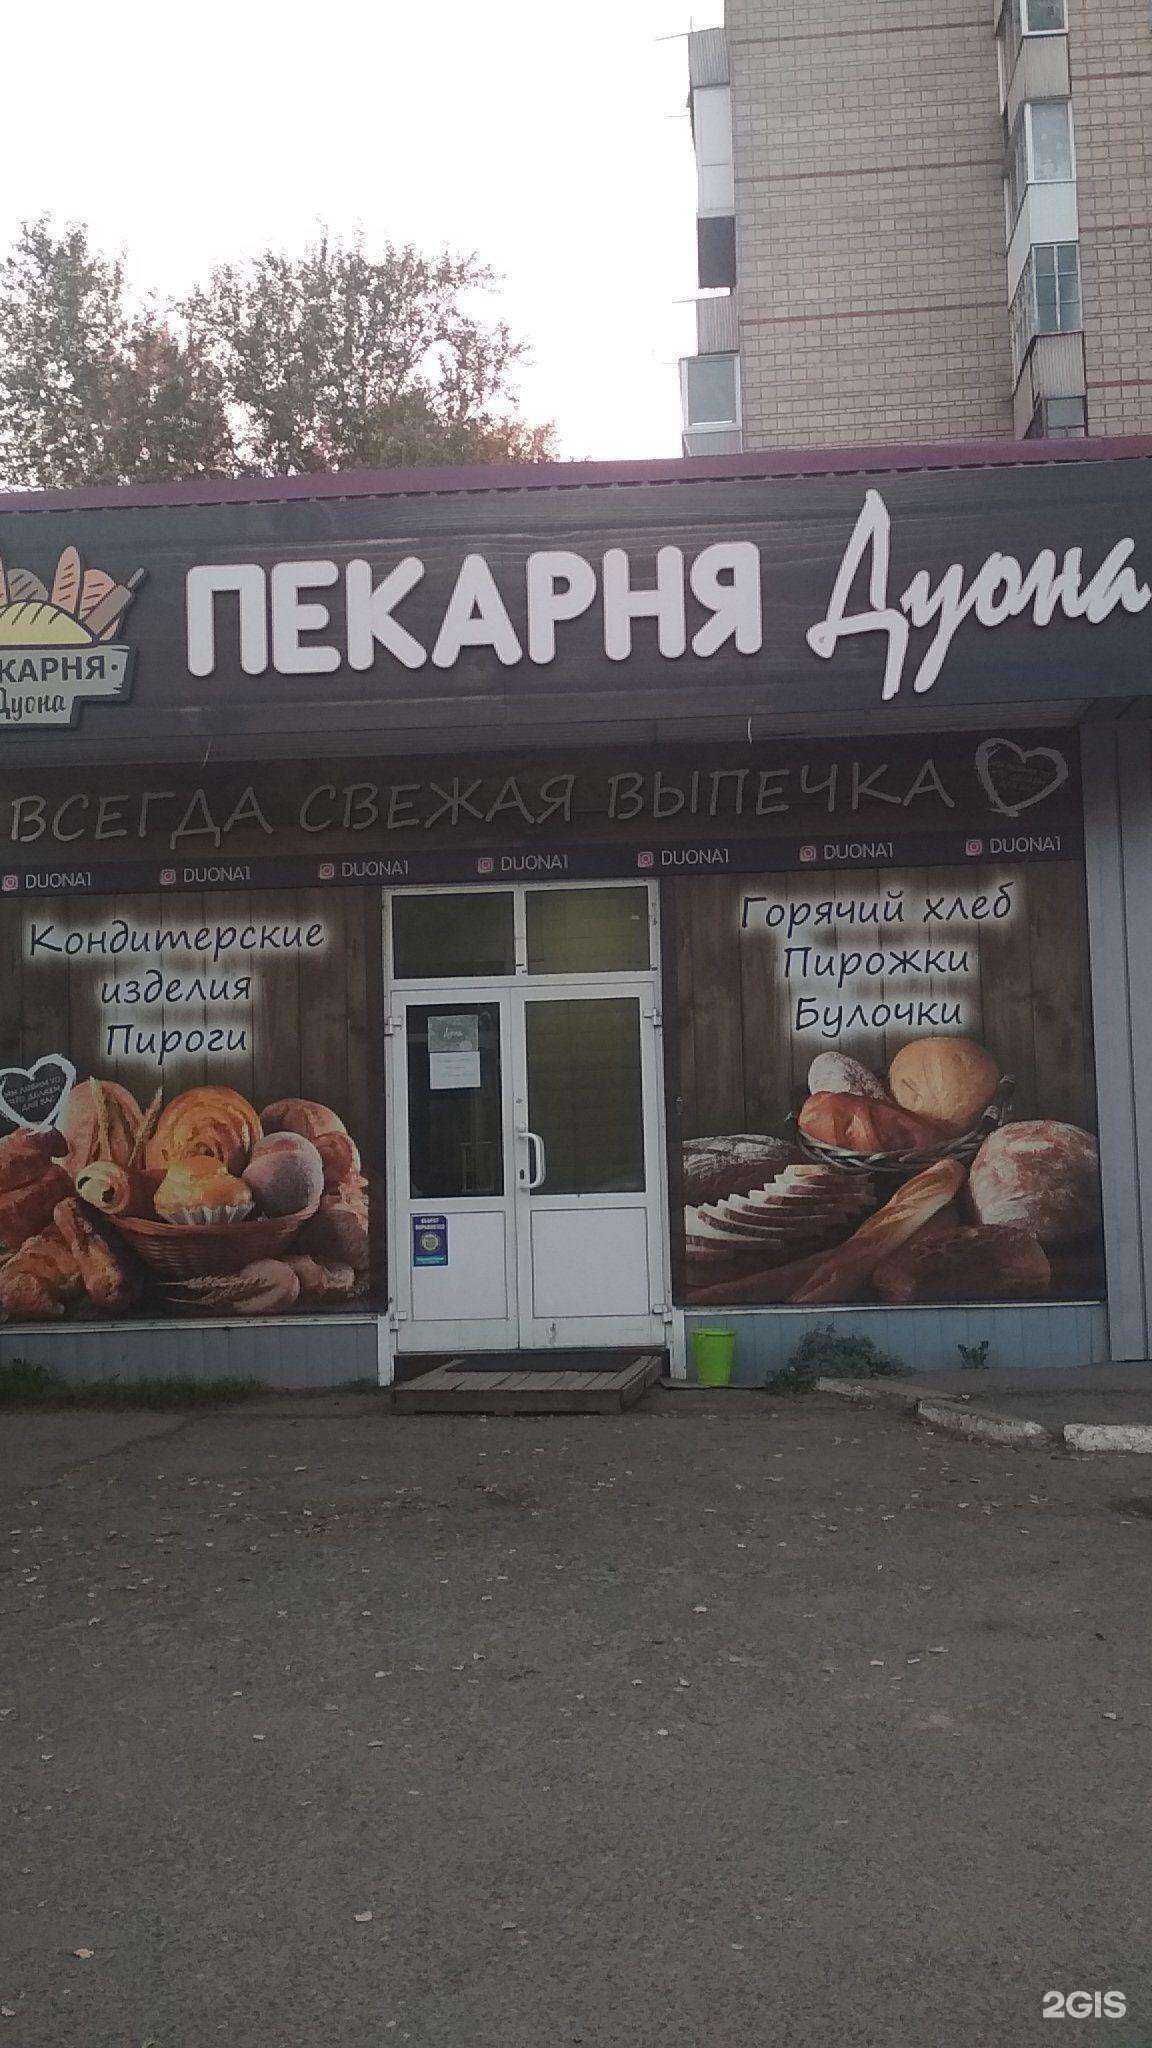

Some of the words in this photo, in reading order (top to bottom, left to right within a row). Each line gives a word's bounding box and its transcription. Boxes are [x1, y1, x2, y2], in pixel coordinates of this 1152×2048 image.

[186, 541, 763, 677] ПЕКАРНЯ
[806, 488, 1152, 701] Дуона
[10, 785, 275, 850] ВСЕГДА
[299, 773, 576, 832] СВЕЖАЯ
[607, 758, 956, 820] ВЫПЕЧКА
[661, 848, 729, 866] DUONA1
[823, 842, 894, 860] DUONA1
[989, 836, 1061, 854] DUONA1
[24, 871, 92, 889] DUONA1
[183, 865, 251, 884] DUONA1
[340, 858, 408, 877] DUONA1
[500, 854, 568, 872] DUONA1
[741, 890, 904, 940] Горячий
[923, 881, 1015, 923] хлеб
[29, 919, 327, 962] Кондитерские
[784, 946, 969, 988] Пирожки
[101, 969, 252, 1004] изделия
[795, 997, 962, 1038] Булочки
[107, 1023, 247, 1066] Пироги
